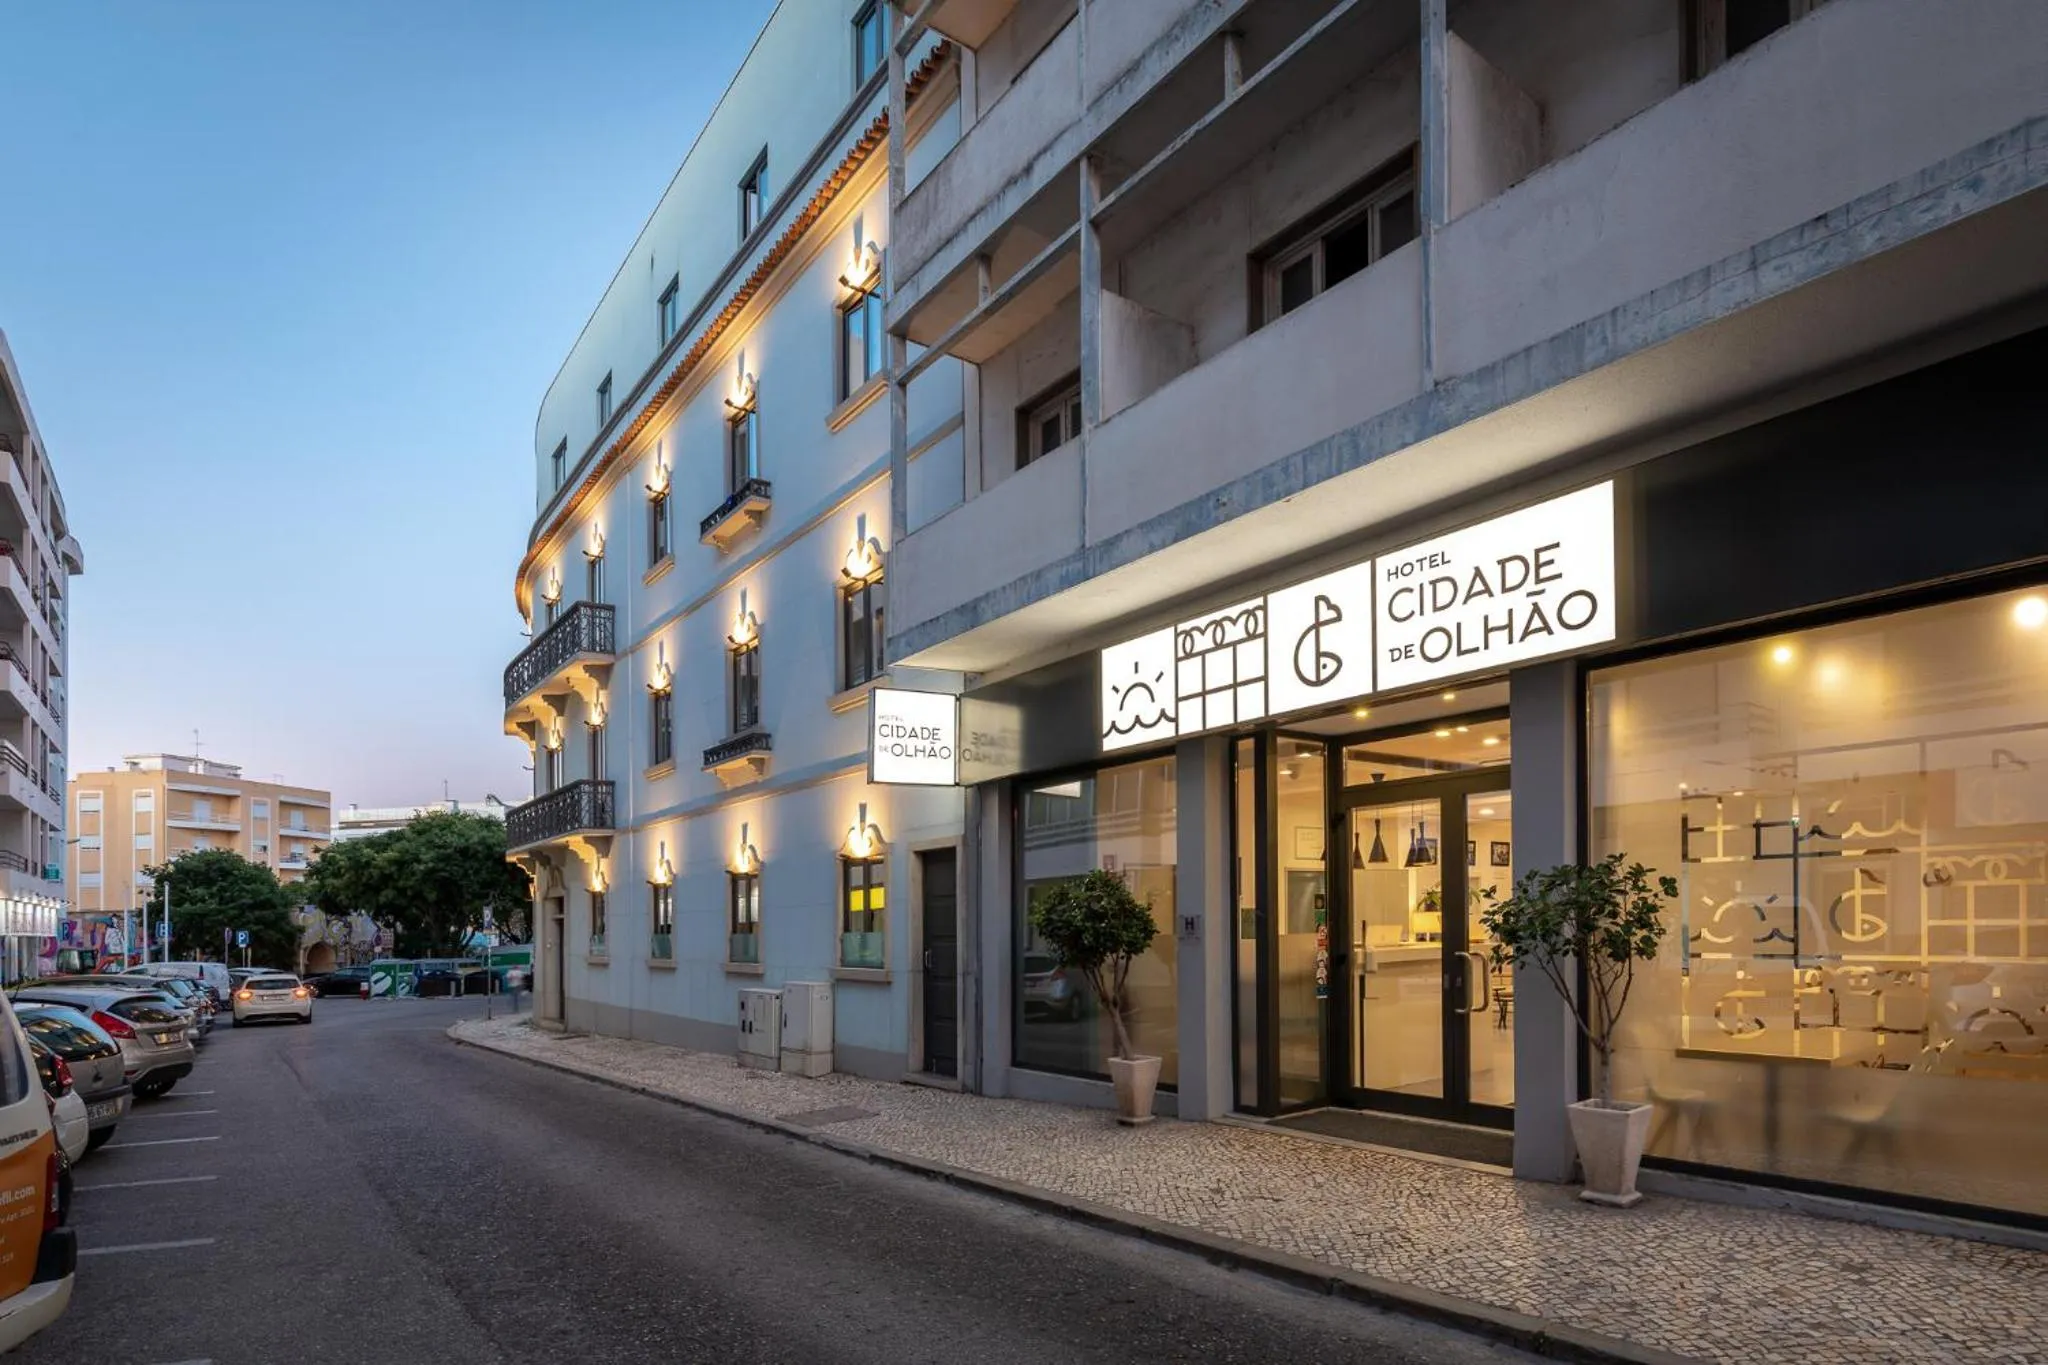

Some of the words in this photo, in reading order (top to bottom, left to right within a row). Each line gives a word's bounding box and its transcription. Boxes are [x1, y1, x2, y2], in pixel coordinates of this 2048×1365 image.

[1387, 551, 1451, 582] HOTEL
[1388, 541, 1563, 623] CIDADE
[1388, 643, 1415, 663] DE
[1420, 588, 1598, 663] OLHÃO
[879, 724, 941, 741] CIDADE
[891, 741, 952, 760] OLHÃO
[1185, 916, 1194, 930] H
